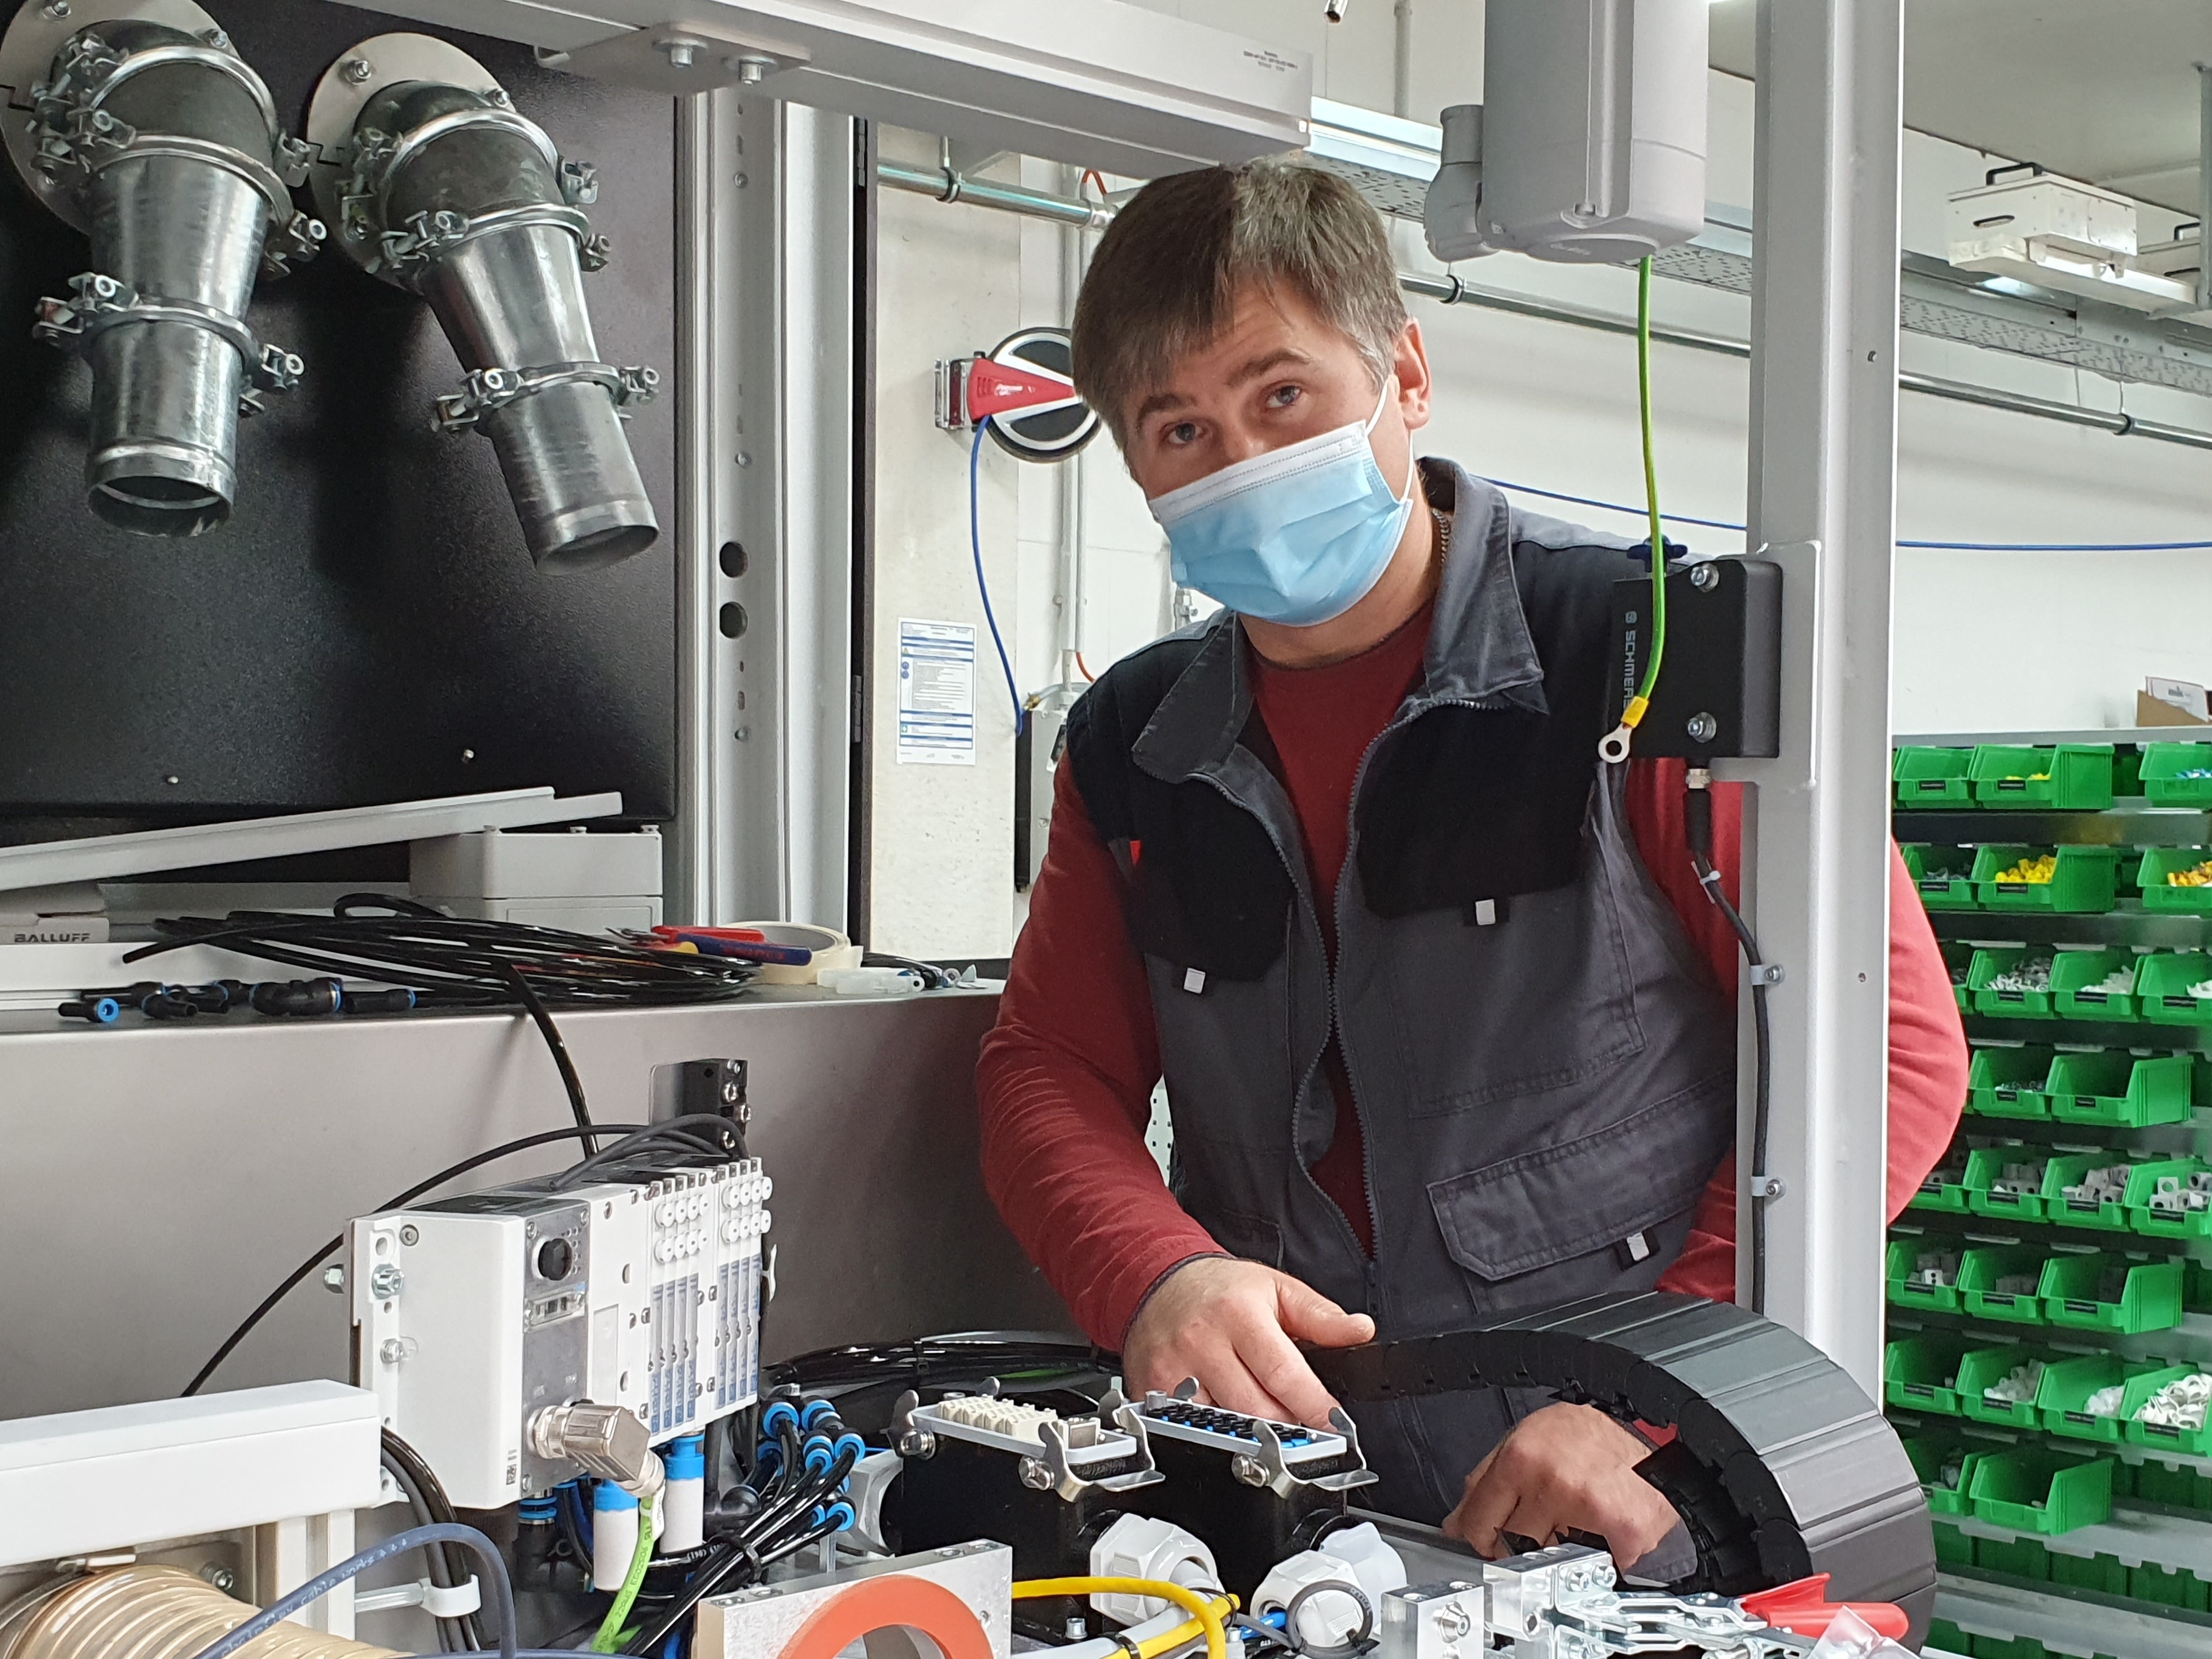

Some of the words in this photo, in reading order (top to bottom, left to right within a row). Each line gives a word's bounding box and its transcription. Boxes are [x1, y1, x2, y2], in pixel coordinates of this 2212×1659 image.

[14, 933, 91, 943] BALLUFF
[302, 1579, 336, 1606] cable
[342, 1556, 375, 1578] works
